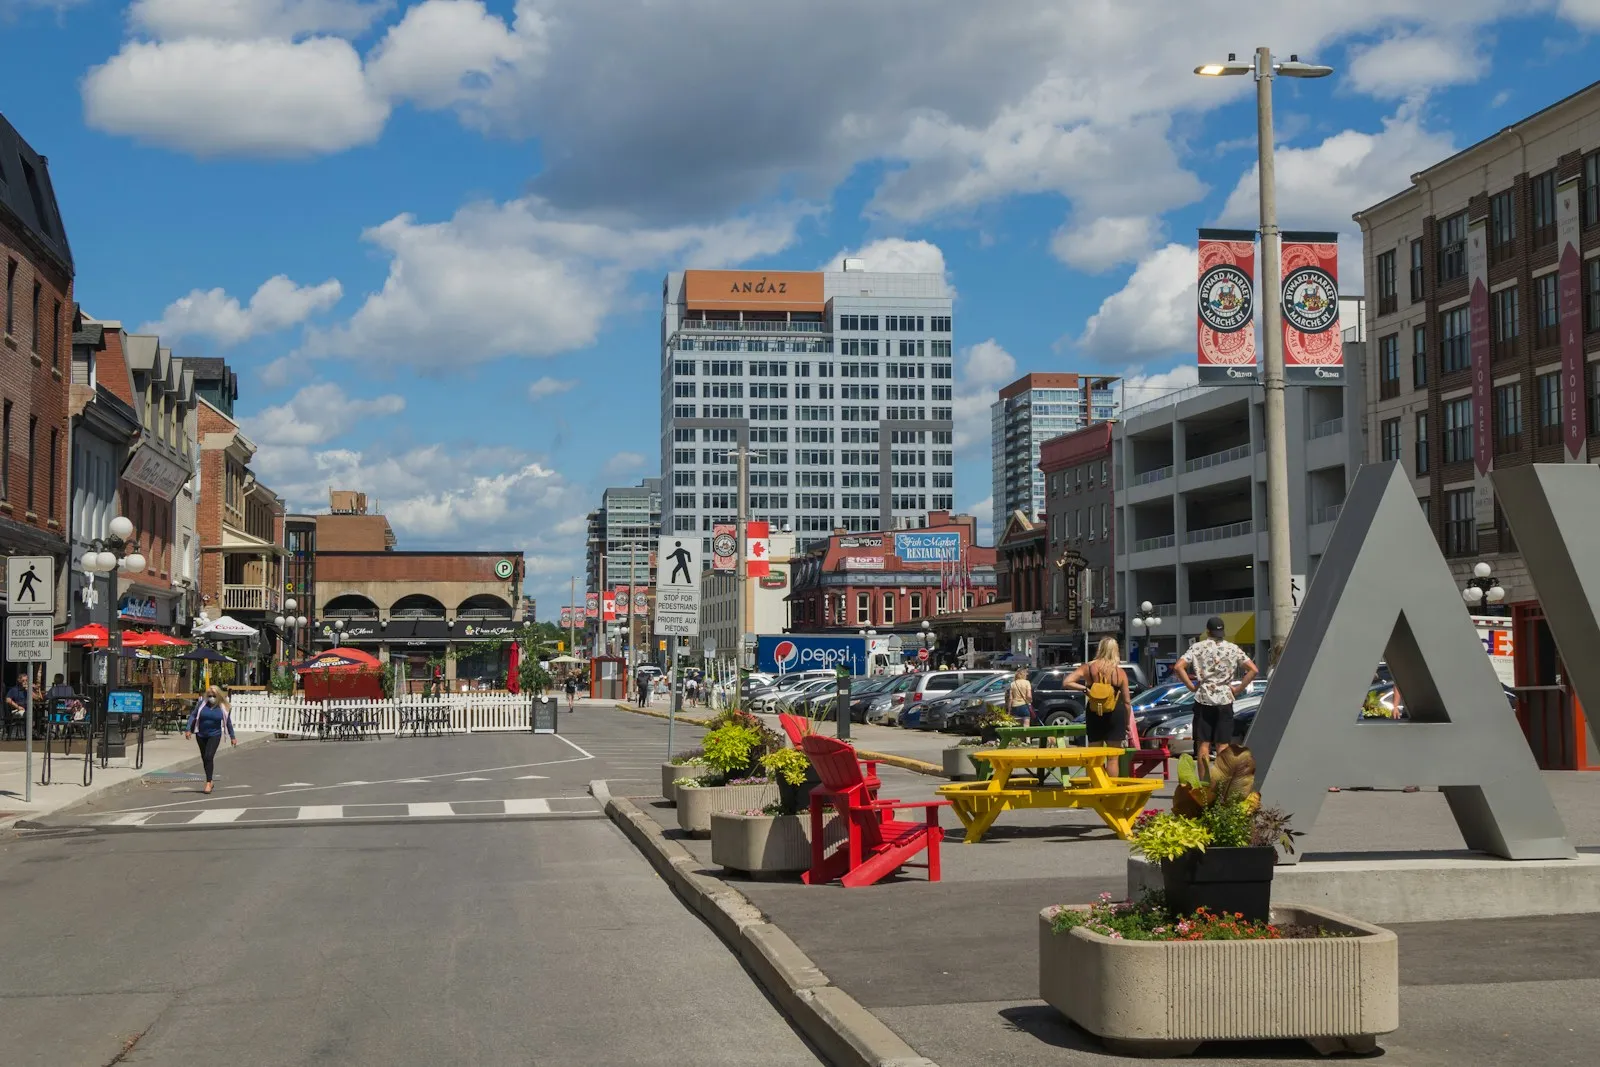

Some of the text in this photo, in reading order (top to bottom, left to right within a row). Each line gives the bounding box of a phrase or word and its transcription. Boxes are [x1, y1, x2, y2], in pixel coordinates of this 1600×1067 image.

[1202, 272, 1250, 299] BYWARD MARKET
[1286, 274, 1335, 300] BYWARD MARKET
[1235, 311, 1245, 322] BY
[1321, 311, 1331, 323] BY
[923, 537, 957, 548] Market
[907, 548, 957, 559] RESTAURANT
[502, 564, 509, 573] P
[1068, 566, 1076, 620] HOUSE
[658, 602, 698, 610] PEDESTRIANS
[16, 619, 44, 627] STOP FOR
[38, 640, 50, 648] AUX
[1130, 640, 1139, 653] P
[800, 645, 850, 665] pepsi
[1157, 663, 1168, 677] P
